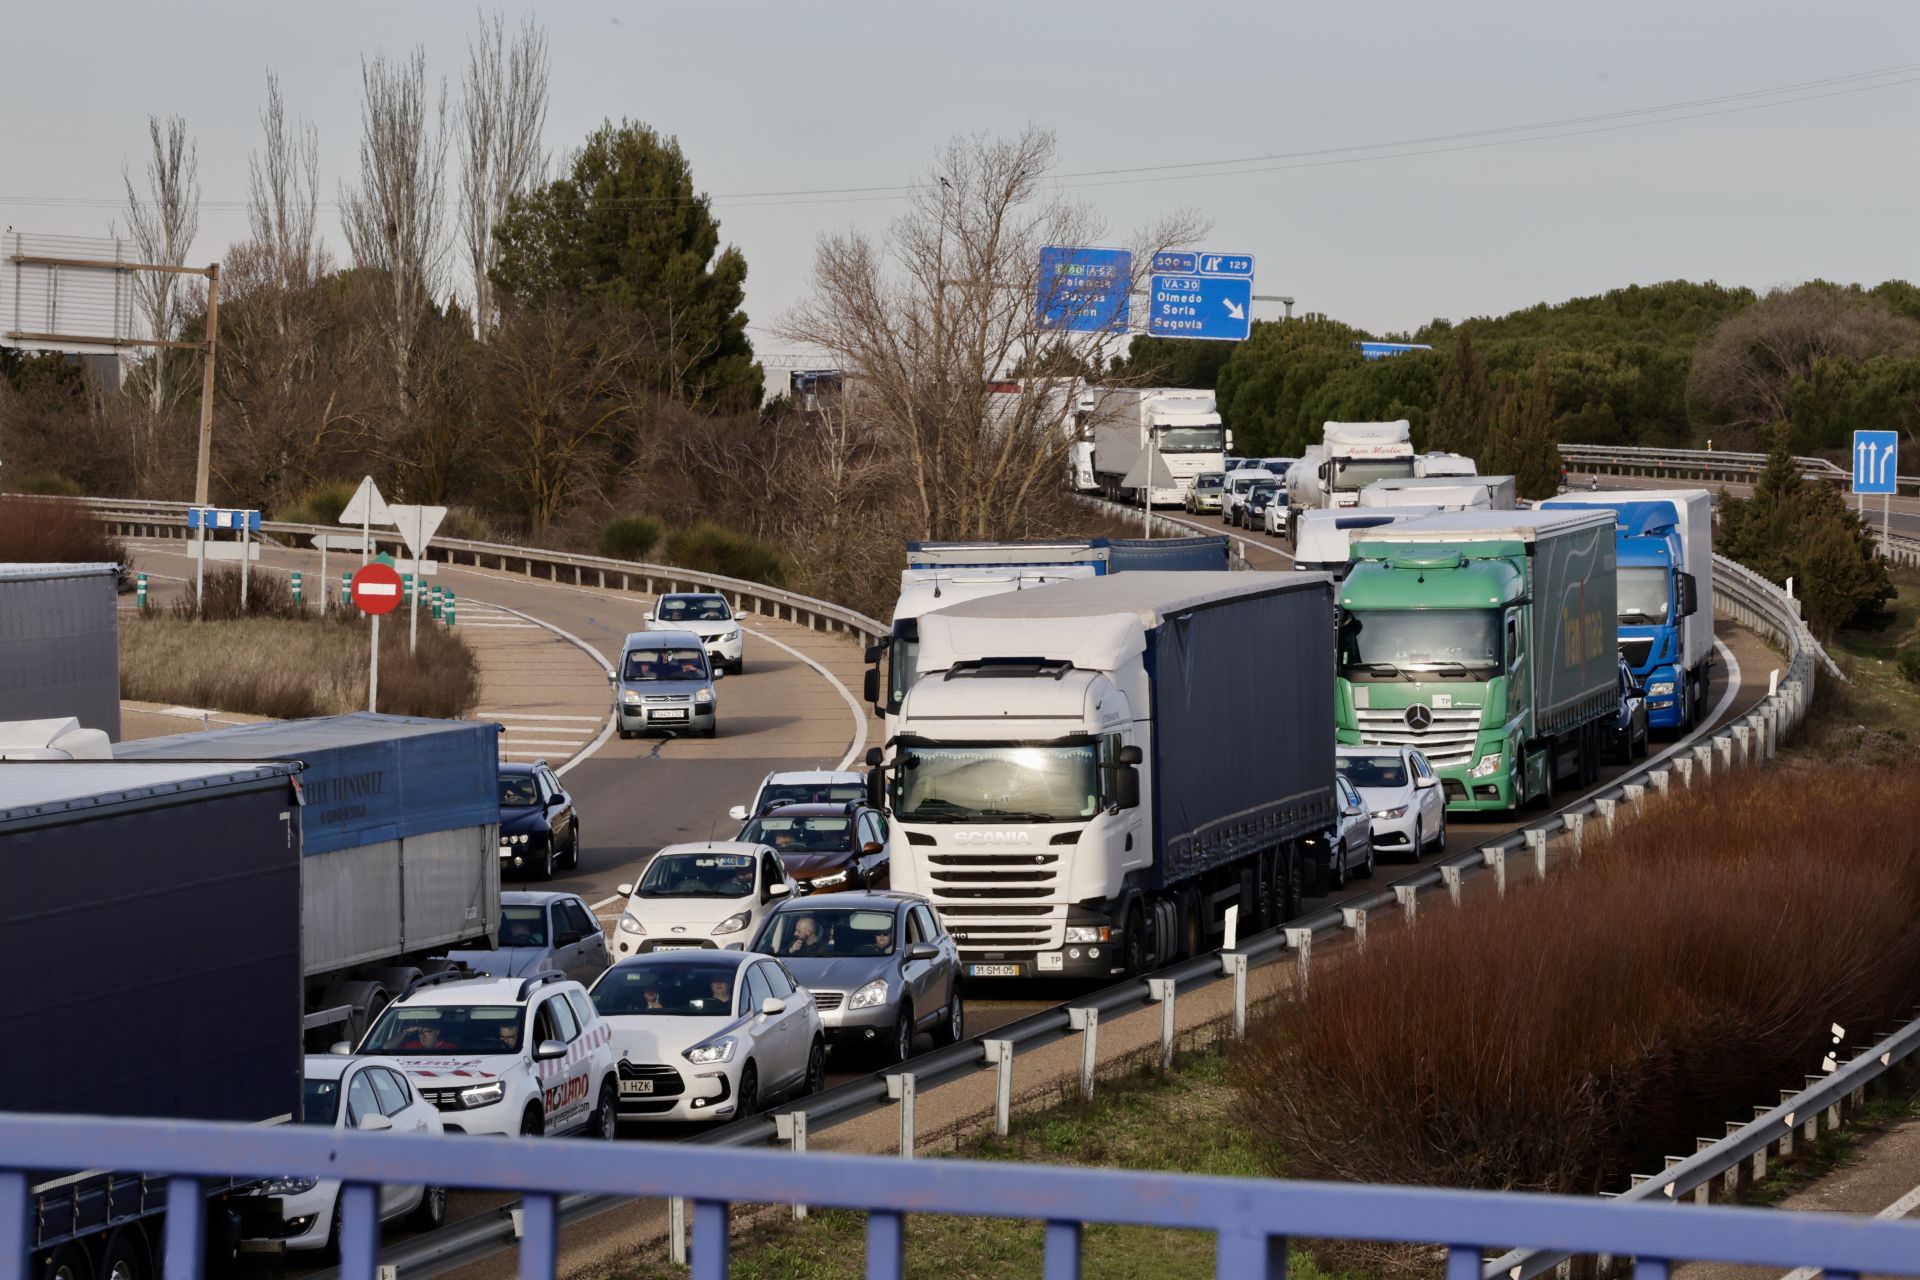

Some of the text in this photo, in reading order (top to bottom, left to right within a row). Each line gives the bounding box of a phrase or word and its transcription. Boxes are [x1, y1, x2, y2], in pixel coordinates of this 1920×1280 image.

[1157, 257, 1179, 266] 500
[1229, 260, 1248, 270] 129
[1164, 280, 1198, 289] VA-30
[1157, 292, 1202, 303] Olmedo
[1163, 304, 1195, 315] Soria
[1154, 317, 1203, 330] Segovia
[954, 831, 1031, 845] SCANIA
[1050, 956, 1061, 965] TP
[631, 1082, 650, 1091] HZK
